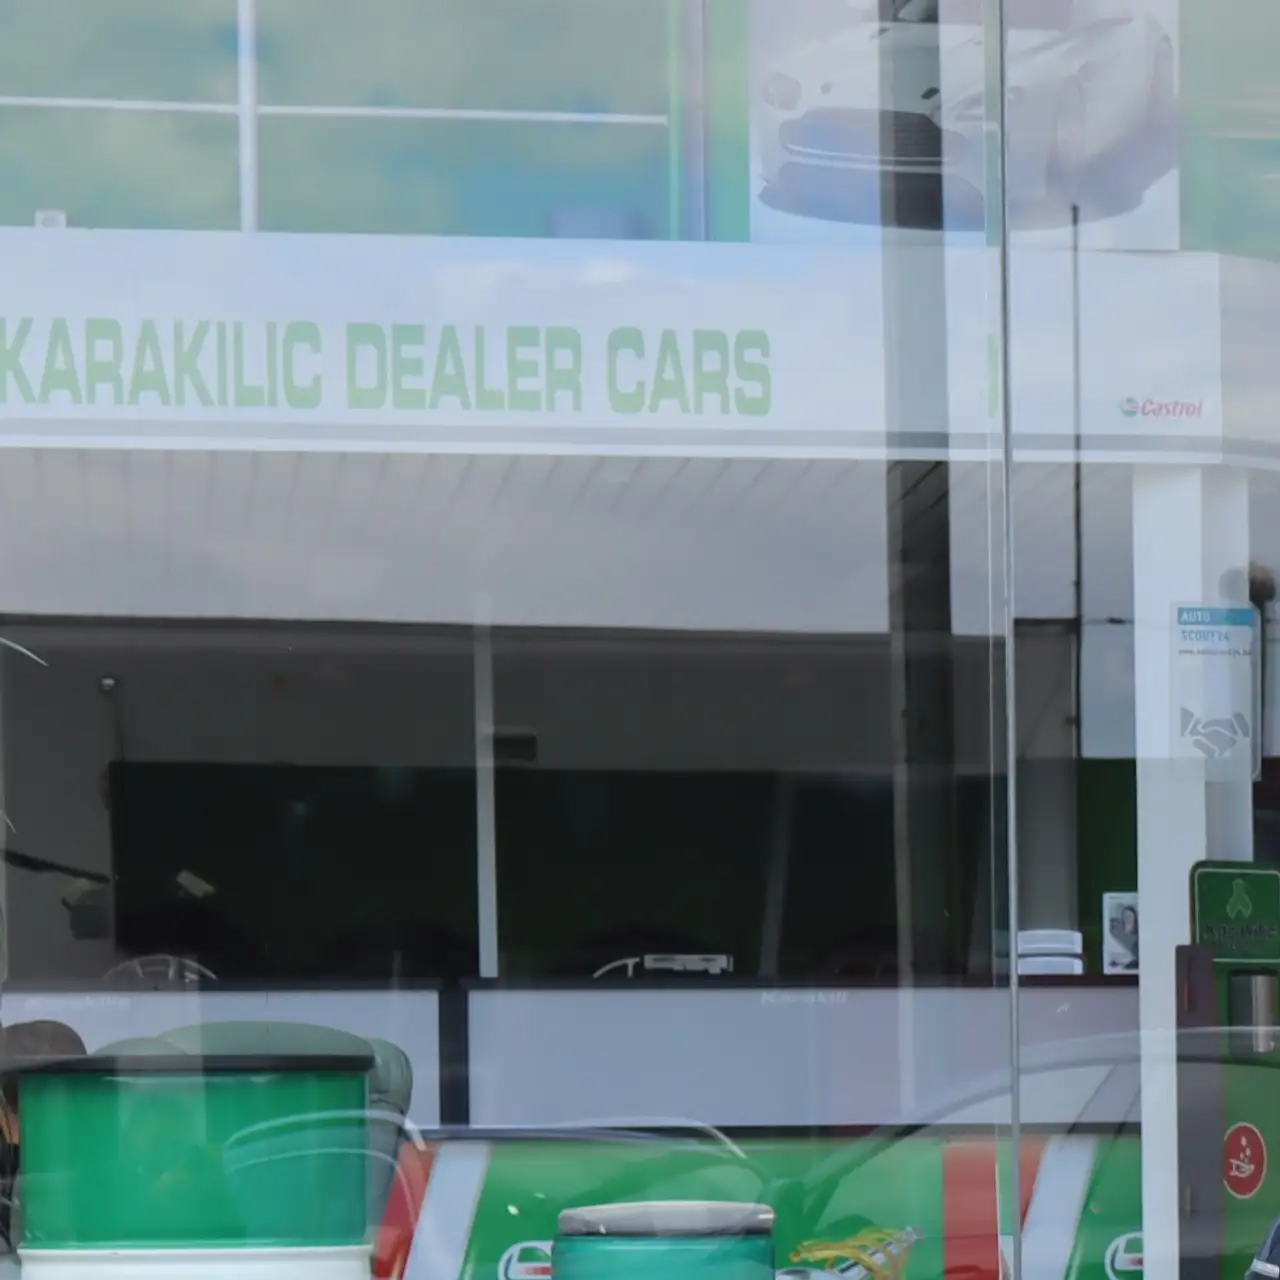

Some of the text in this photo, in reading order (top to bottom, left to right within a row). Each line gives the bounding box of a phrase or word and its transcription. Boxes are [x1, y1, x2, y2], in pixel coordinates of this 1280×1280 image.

[0, 317, 772, 416] KARAKILIC DEALER CARS
